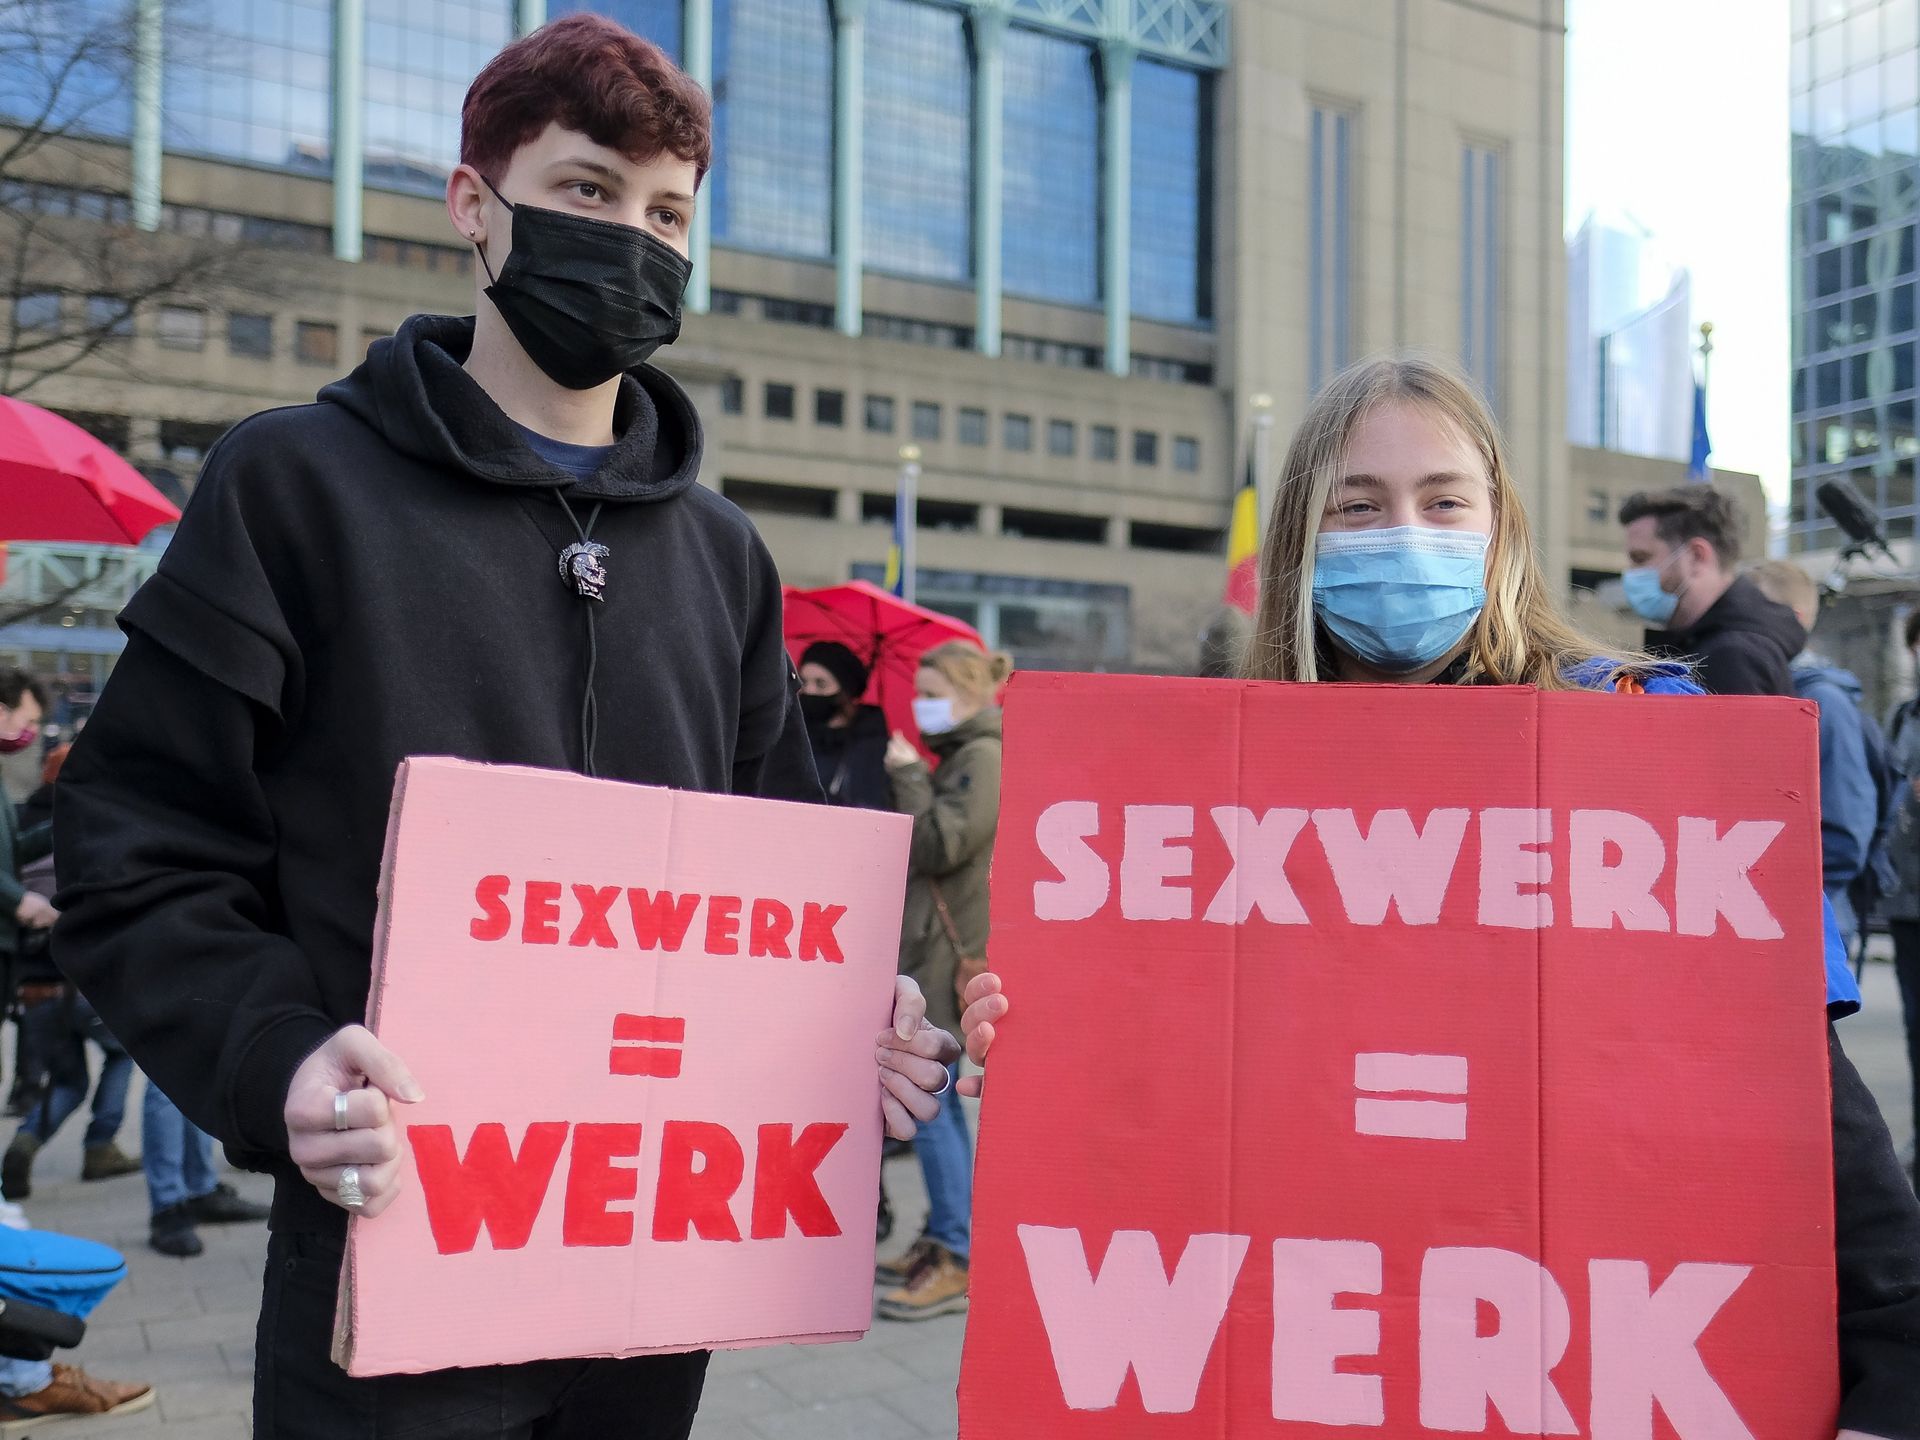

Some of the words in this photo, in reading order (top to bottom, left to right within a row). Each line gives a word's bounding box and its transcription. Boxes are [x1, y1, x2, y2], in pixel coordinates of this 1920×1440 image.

[470, 874, 848, 964] SEXWERK
[1033, 801, 1785, 940] SEXWERK
[406, 1119, 849, 1256] WERK
[1017, 1224, 1755, 1440] WERK
